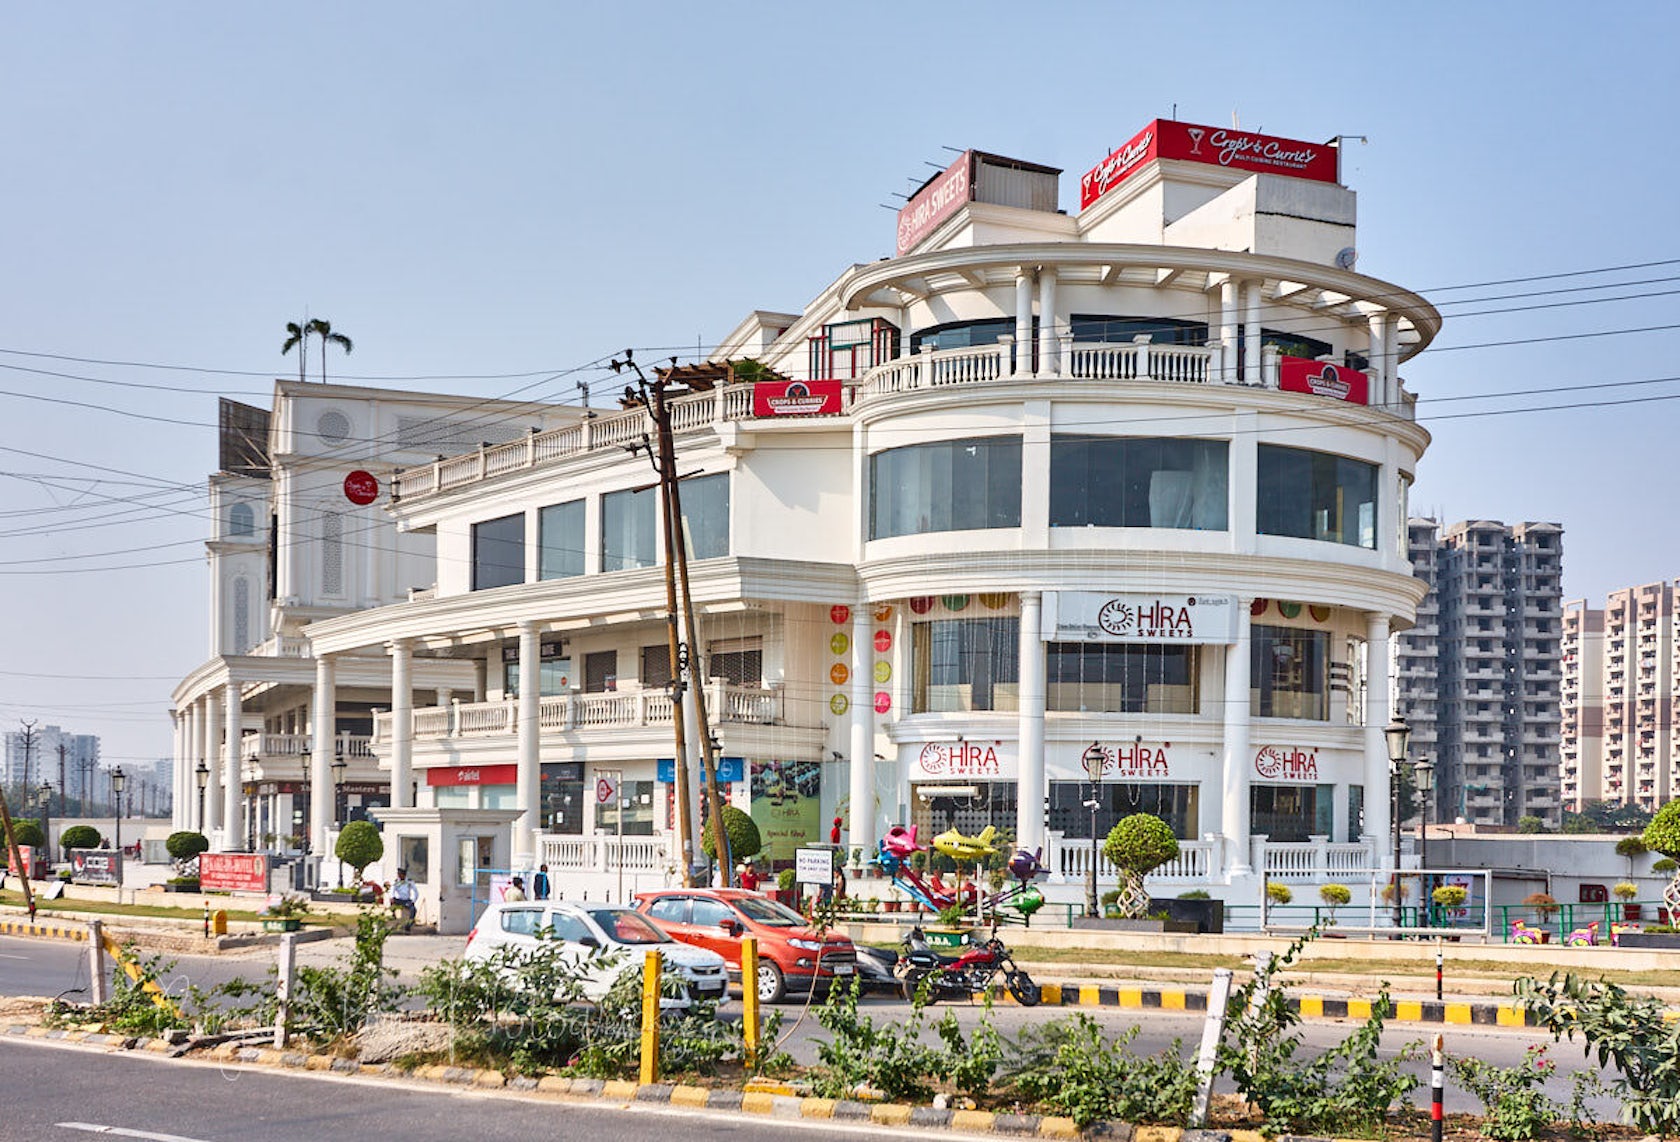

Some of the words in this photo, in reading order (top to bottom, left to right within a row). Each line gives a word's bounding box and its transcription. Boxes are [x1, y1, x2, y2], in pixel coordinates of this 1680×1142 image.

[1253, 139, 1263, 153] &
[1263, 141, 1317, 164] Curries
[912, 198, 930, 230] HIRA
[930, 166, 966, 217] SWEETS
[1137, 600, 1192, 629] HIRA
[1137, 629, 1193, 637] SWEETS
[949, 741, 999, 767] HIRA
[1118, 743, 1168, 769] HIRA
[1282, 747, 1317, 772] HIRA
[464, 769, 480, 782] airtel
[950, 767, 999, 775] SWEETS
[1121, 769, 1169, 777] SWEETS
[1283, 772, 1318, 780] SWEETS
[342, 784, 376, 793] Masters
[808, 857, 829, 865] PARKING
